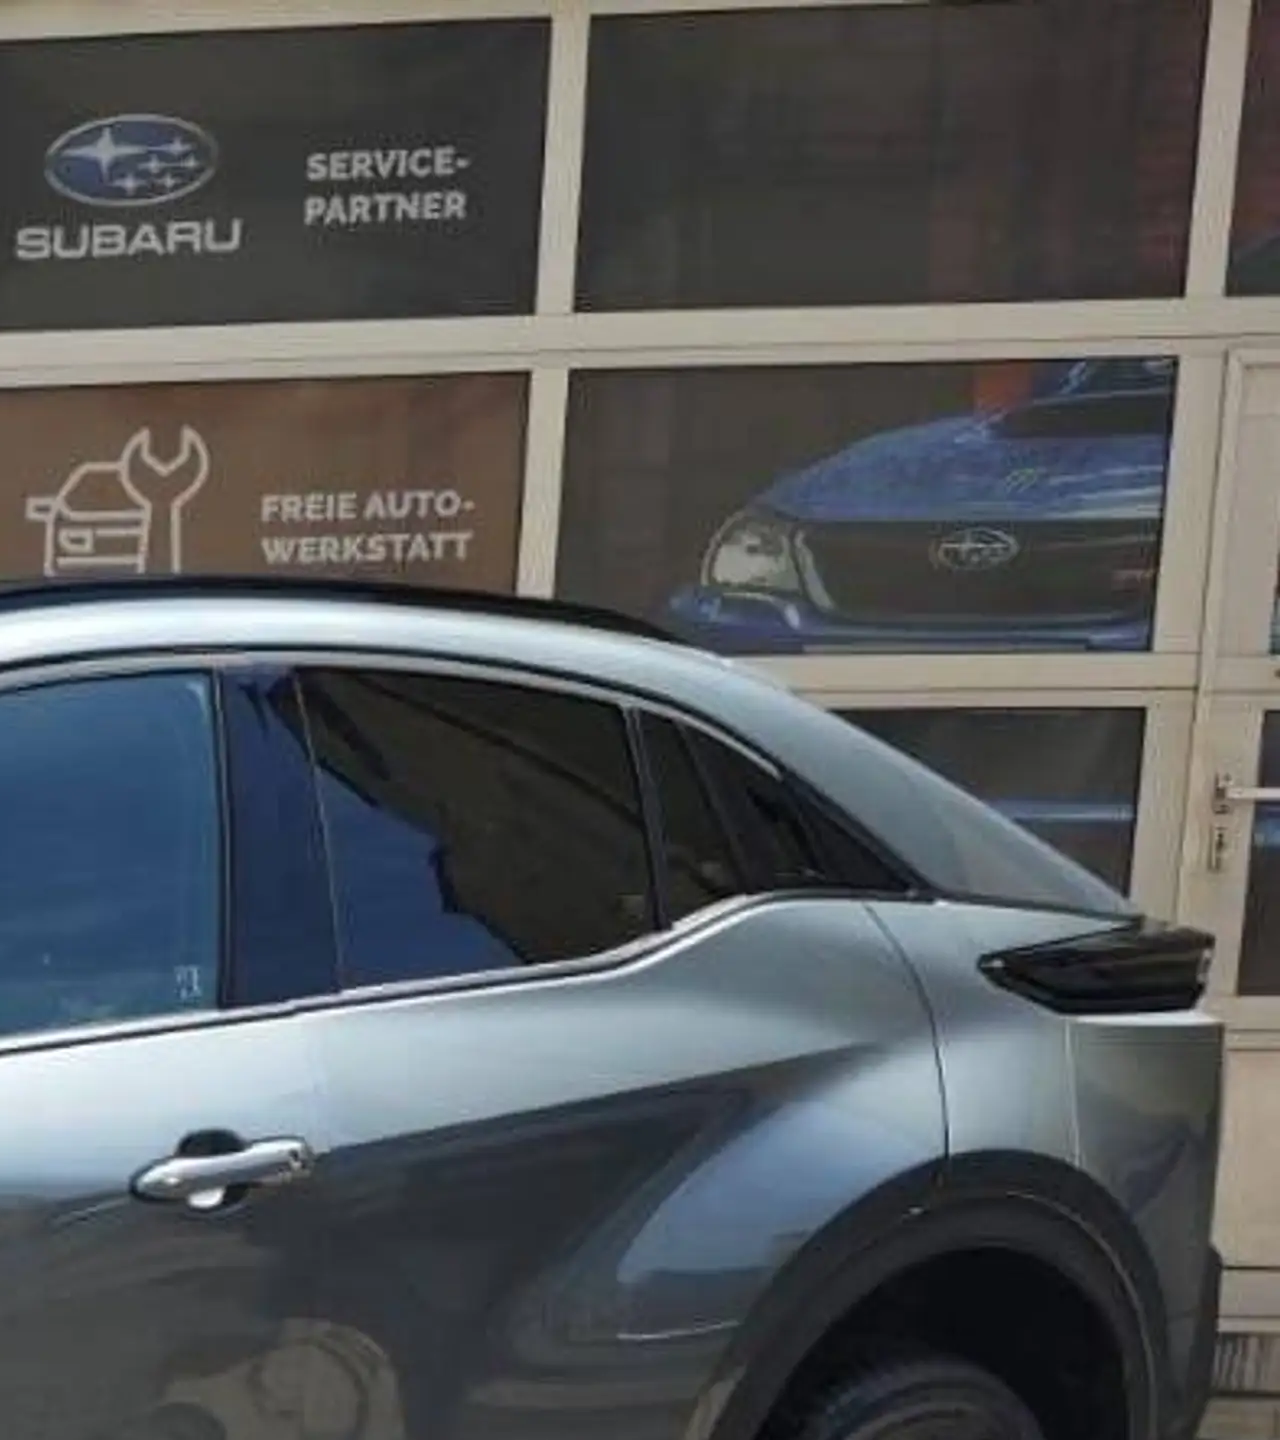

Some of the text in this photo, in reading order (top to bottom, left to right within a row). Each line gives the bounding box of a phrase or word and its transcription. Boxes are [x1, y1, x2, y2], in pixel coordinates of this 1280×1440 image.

[305, 146, 472, 183] SERVICE-
[303, 190, 467, 226] PARTNER
[15, 218, 243, 261] SUBARU
[260, 489, 476, 523] FREIE AUTO-
[260, 530, 474, 565] WERKSTATT
